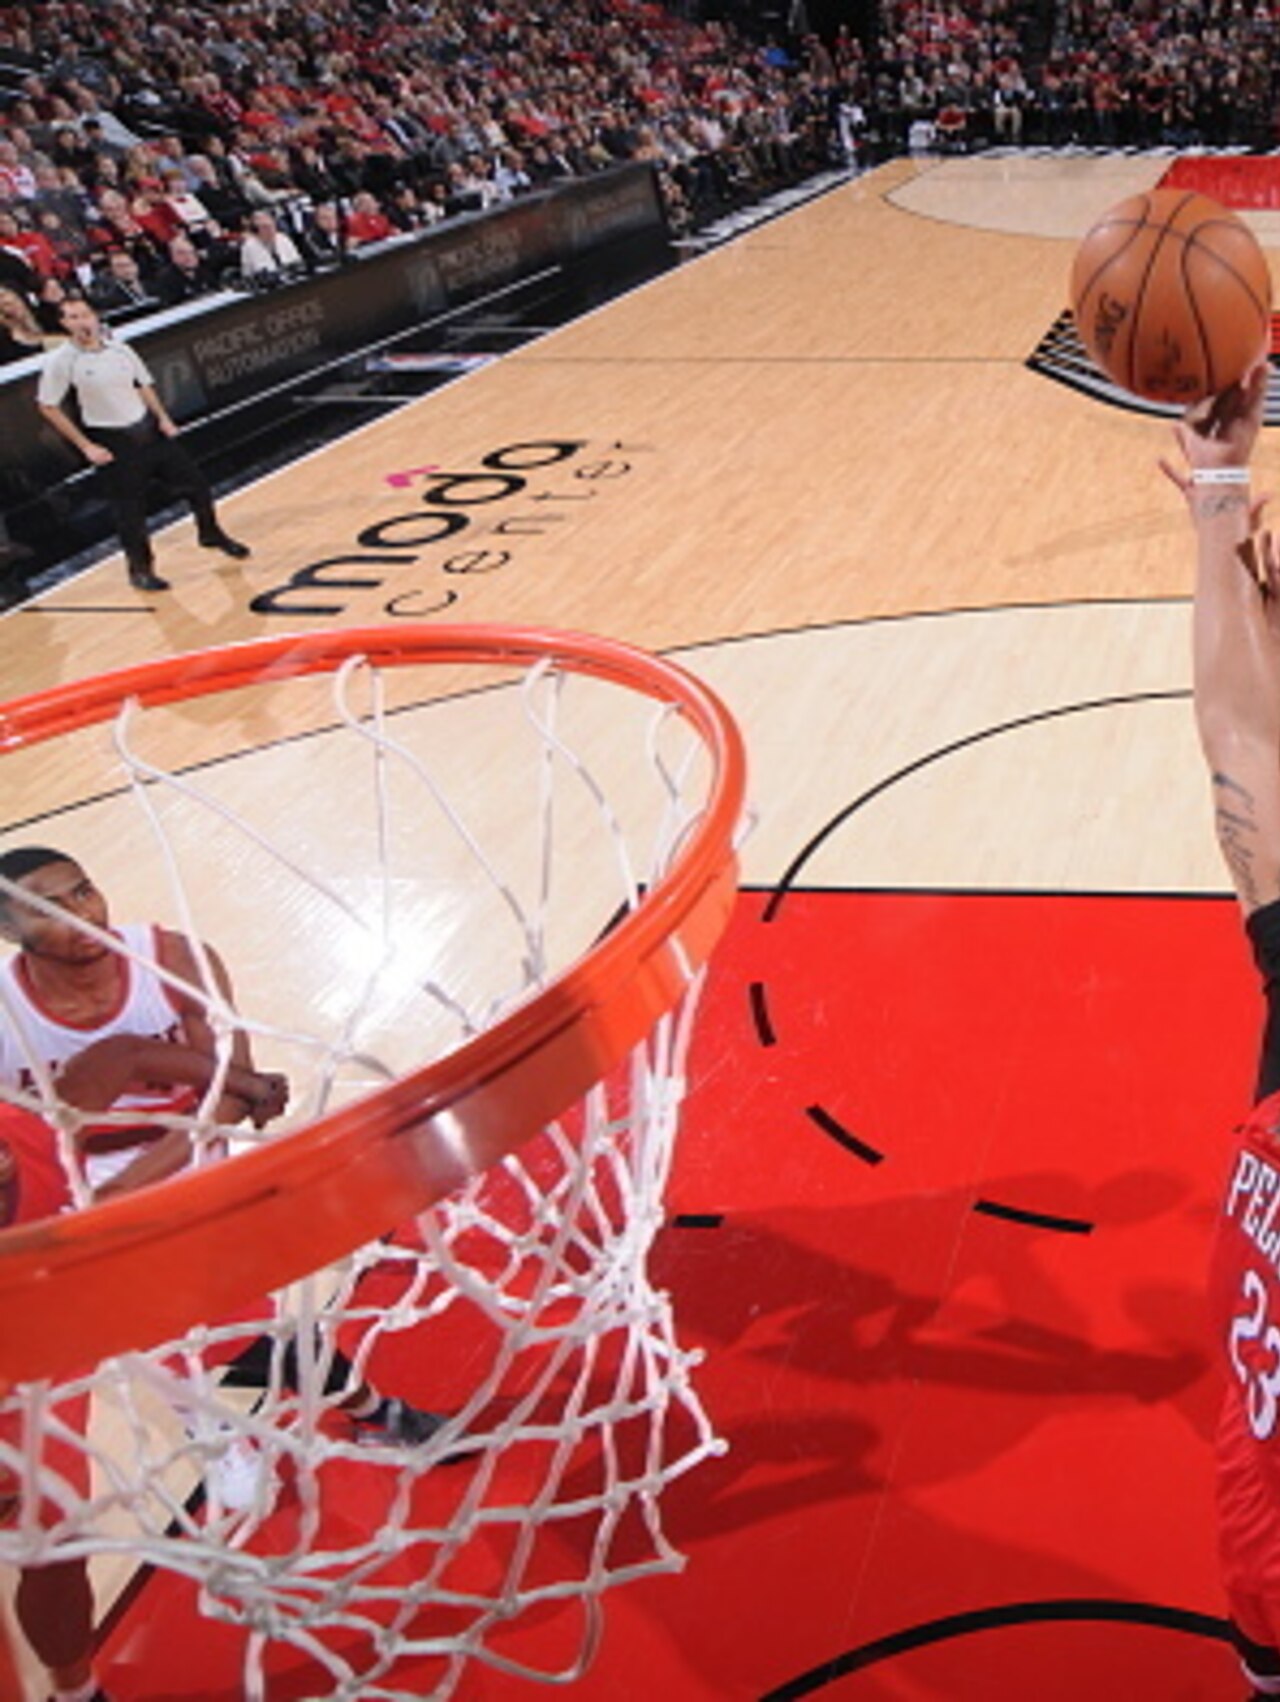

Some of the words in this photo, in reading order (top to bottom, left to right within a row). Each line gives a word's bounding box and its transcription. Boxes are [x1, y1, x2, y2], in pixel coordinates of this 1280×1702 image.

[193, 323, 263, 362] PACIFIC
[249, 441, 588, 616] moda
[384, 441, 656, 617] center
